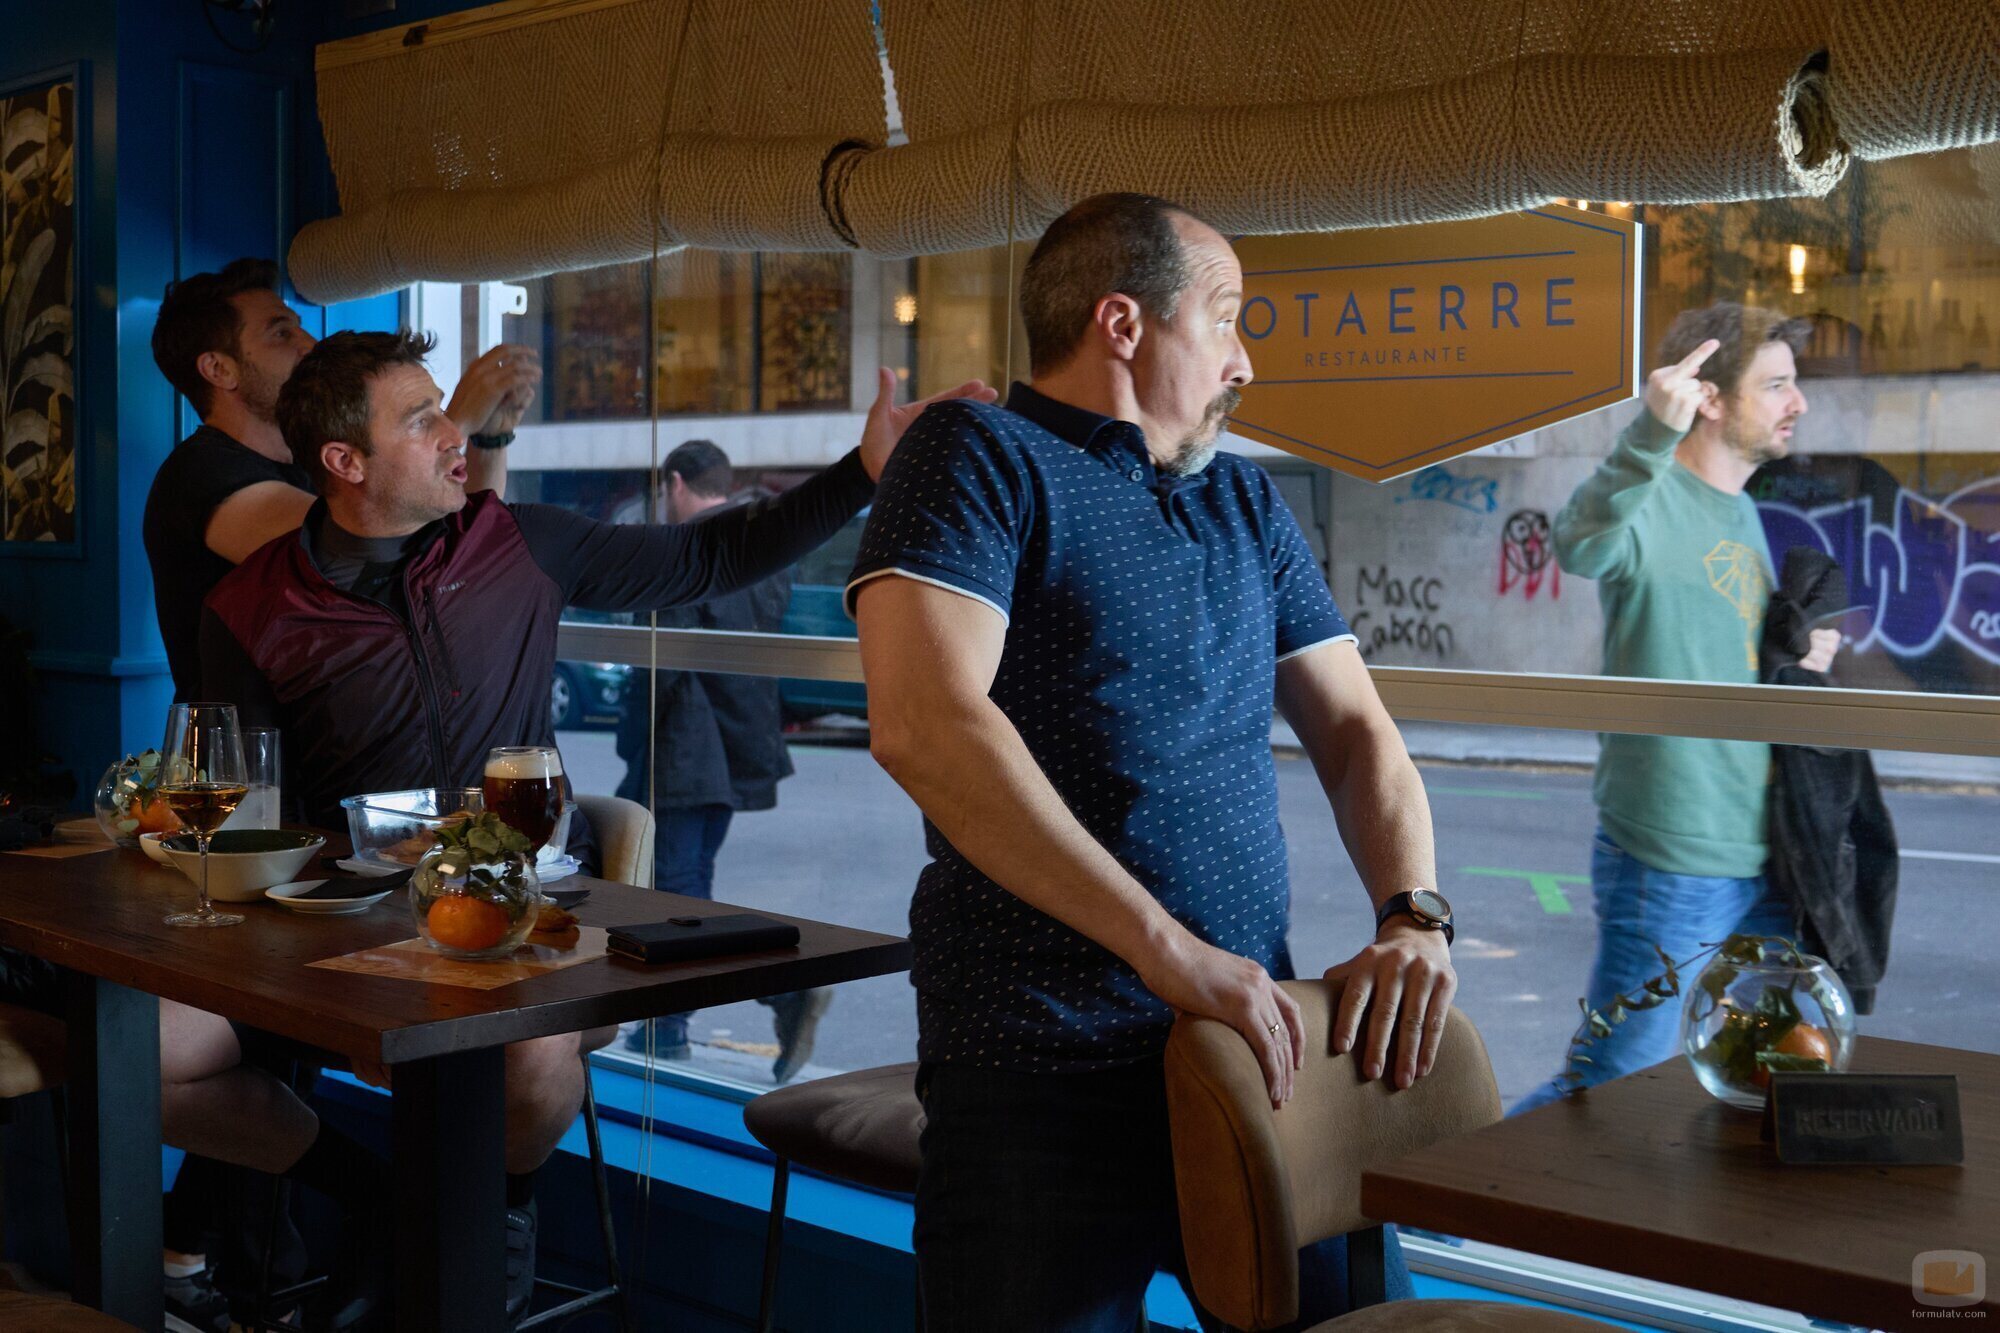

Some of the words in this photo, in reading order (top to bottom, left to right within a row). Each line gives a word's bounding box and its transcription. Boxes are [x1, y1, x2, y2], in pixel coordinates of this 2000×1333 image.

[1241, 278, 1575, 340] OTAERRE
[1305, 347, 1467, 367] RESTAURANTE
[1795, 1105, 1938, 1135] RESERVADO
